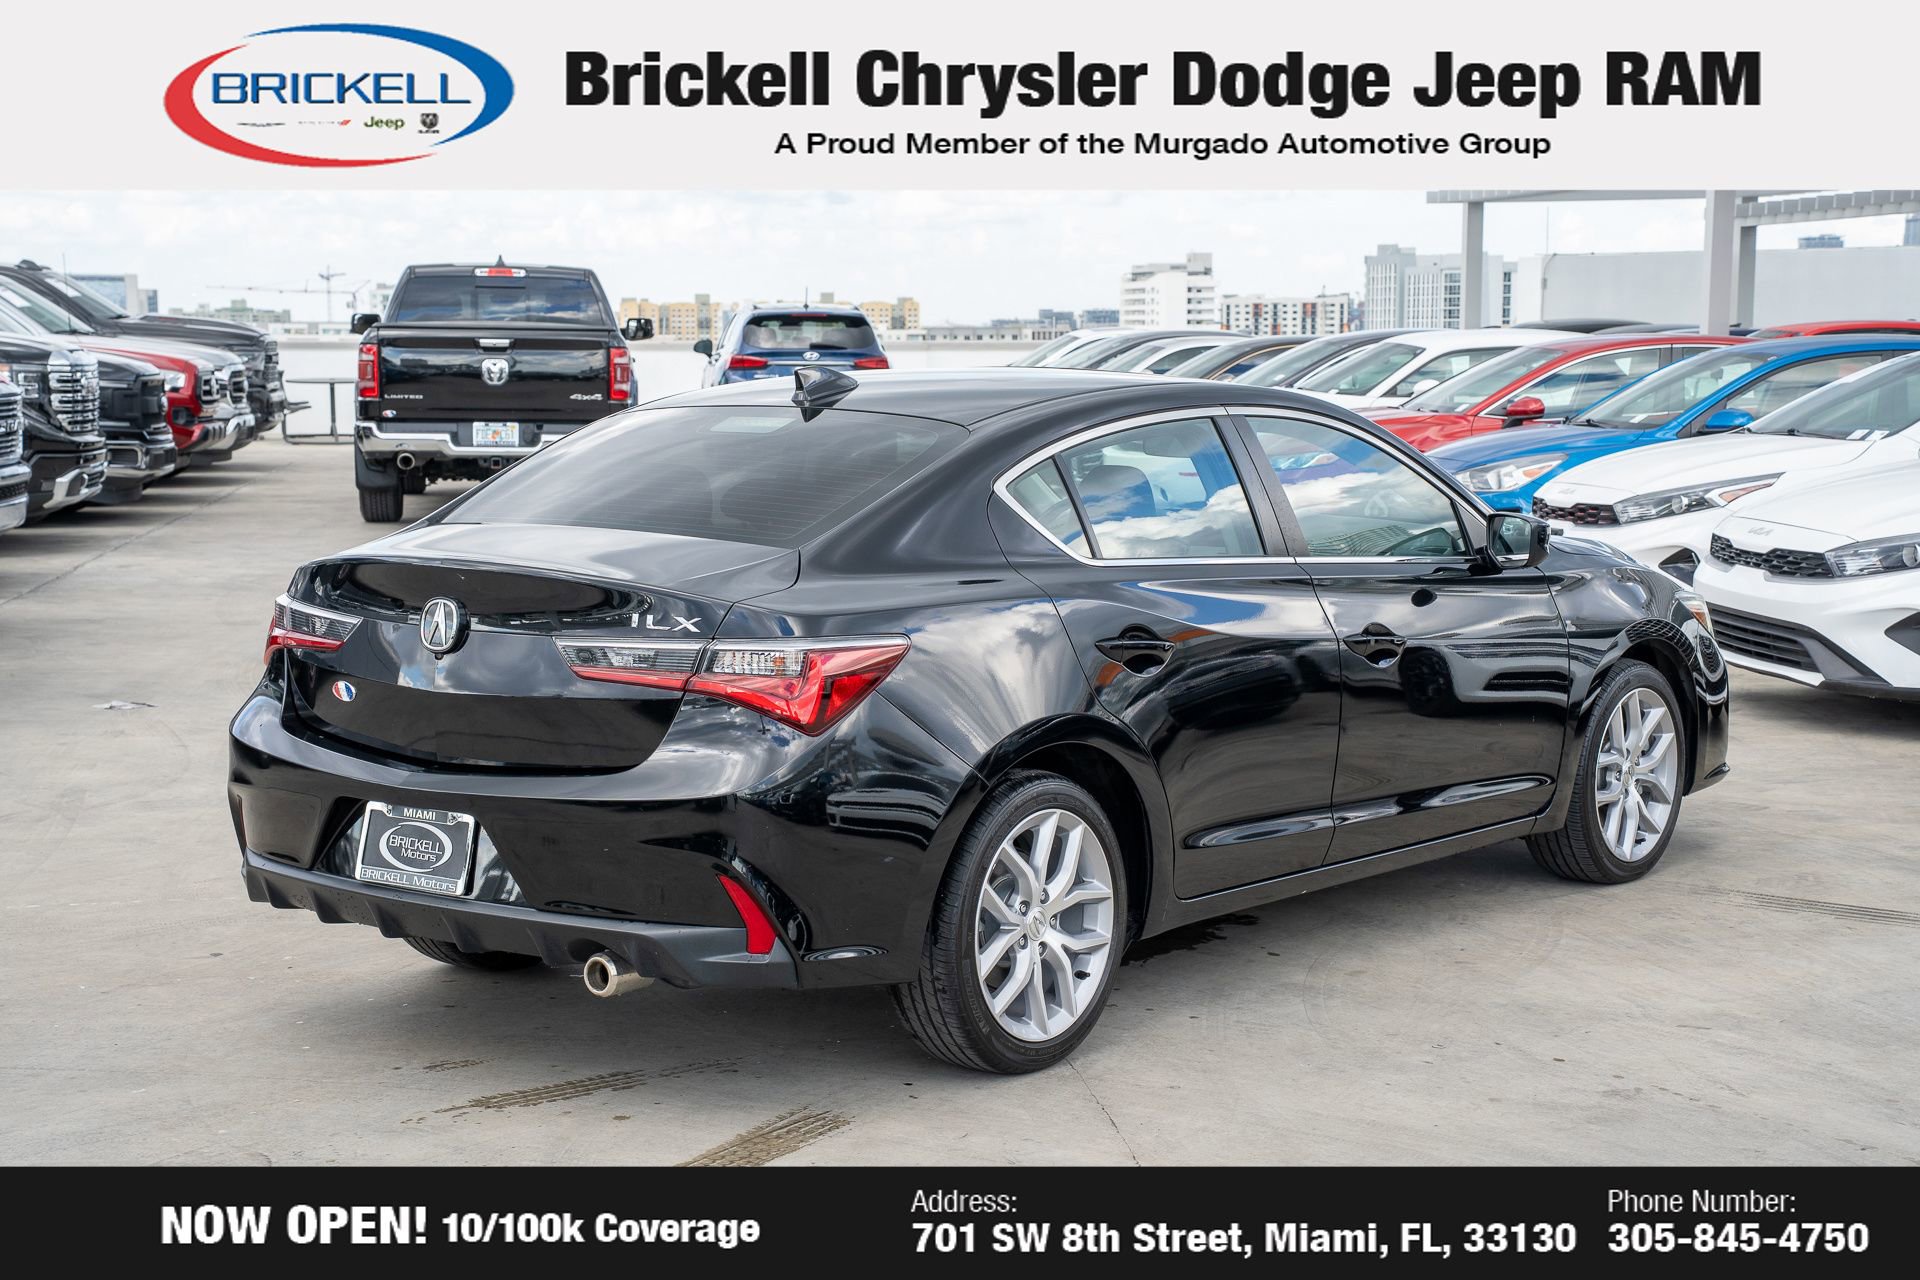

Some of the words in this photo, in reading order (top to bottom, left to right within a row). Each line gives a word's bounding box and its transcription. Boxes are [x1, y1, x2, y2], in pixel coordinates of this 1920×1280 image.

[631, 612, 702, 633] ILX
[403, 807, 436, 821] MIAMI
[388, 834, 443, 855] BRICKELL
[400, 848, 437, 863] Motors
[360, 868, 410, 885] BRICKELL
[412, 875, 457, 892] Motors
